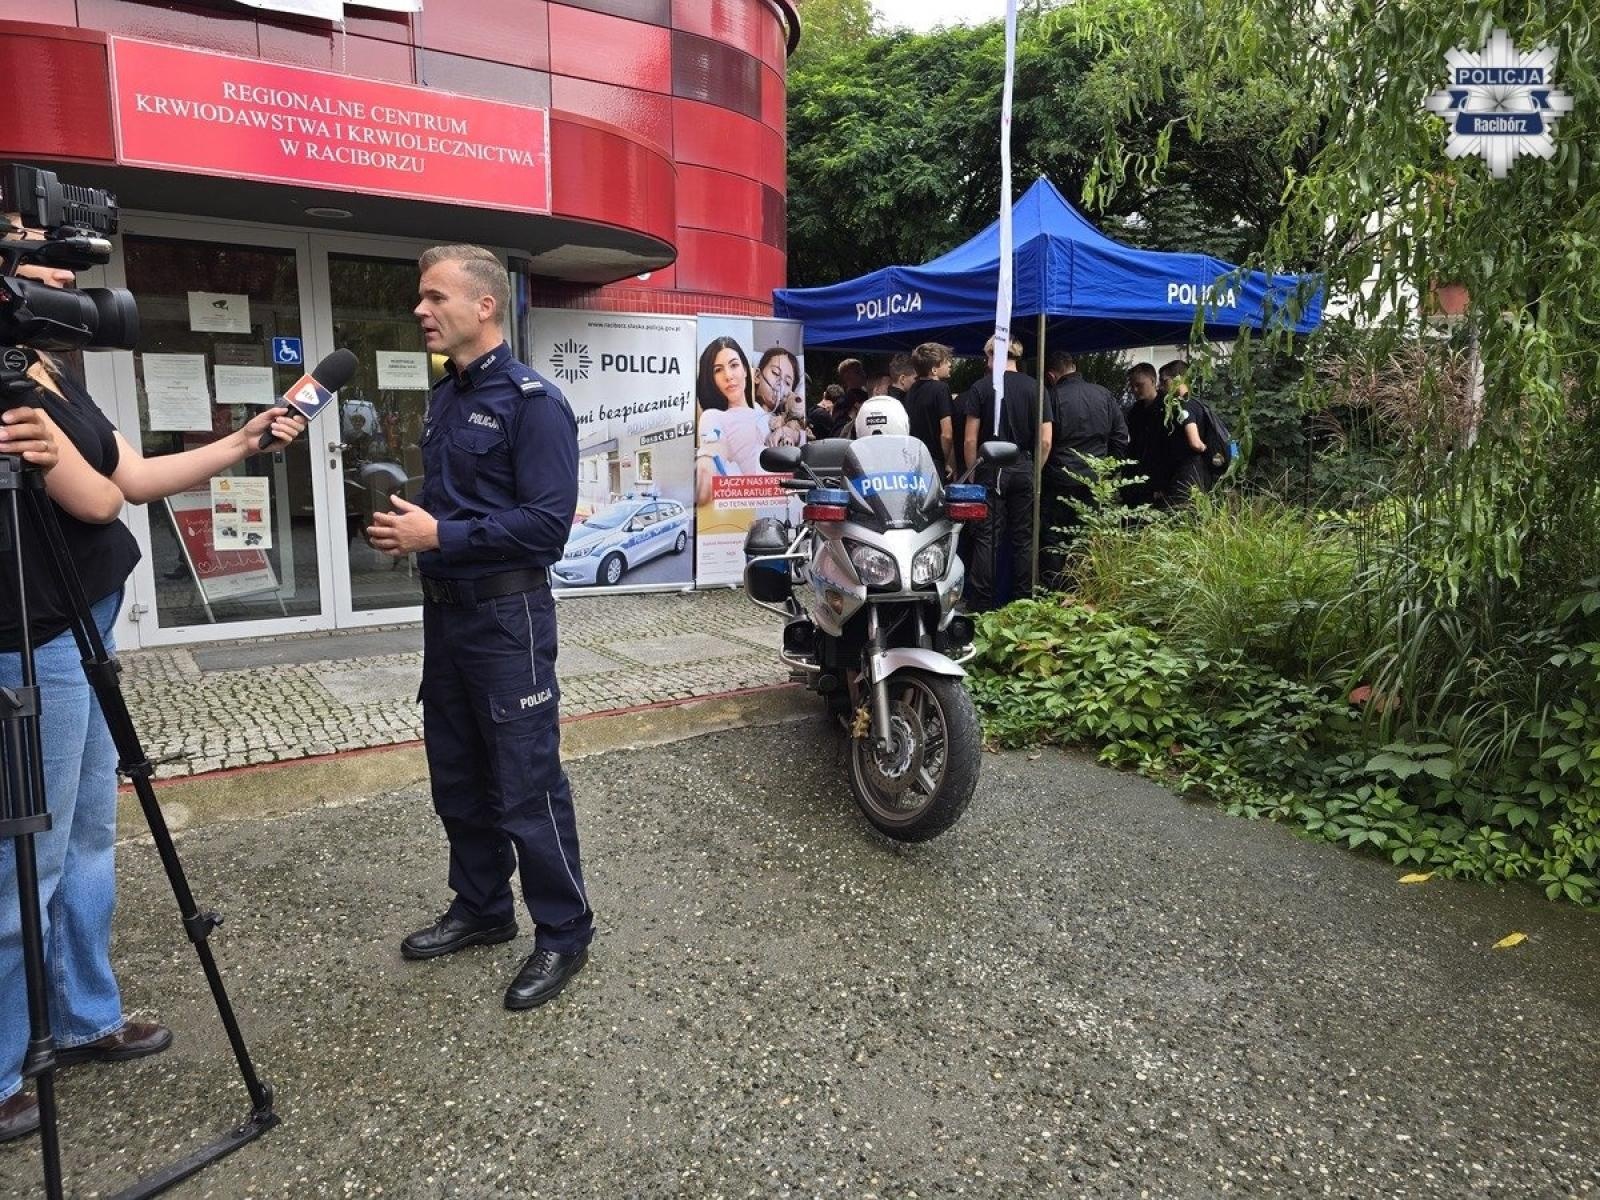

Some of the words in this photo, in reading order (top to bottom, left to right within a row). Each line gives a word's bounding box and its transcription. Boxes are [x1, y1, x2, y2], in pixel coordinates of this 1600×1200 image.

[222, 81, 366, 120] REGIONALNE
[370, 106, 468, 136] CENTRUM
[135, 93, 331, 139] KRWIODAWSTWA
[335, 123, 342, 140] I
[348, 125, 535, 168] KRWIOLECZNICTWA
[280, 138, 300, 156] W
[306, 142, 425, 173] RACIBORZU
[855, 292, 922, 322] POLICJA
[600, 353, 681, 375] POLICJA
[599, 391, 690, 423] bezpieczniej!
[467, 412, 500, 430] POLICJA
[678, 422, 693, 437] 42
[714, 488, 742, 498] KTÓRA
[743, 487, 773, 497] RATUJE
[861, 475, 928, 496] POLICJA
